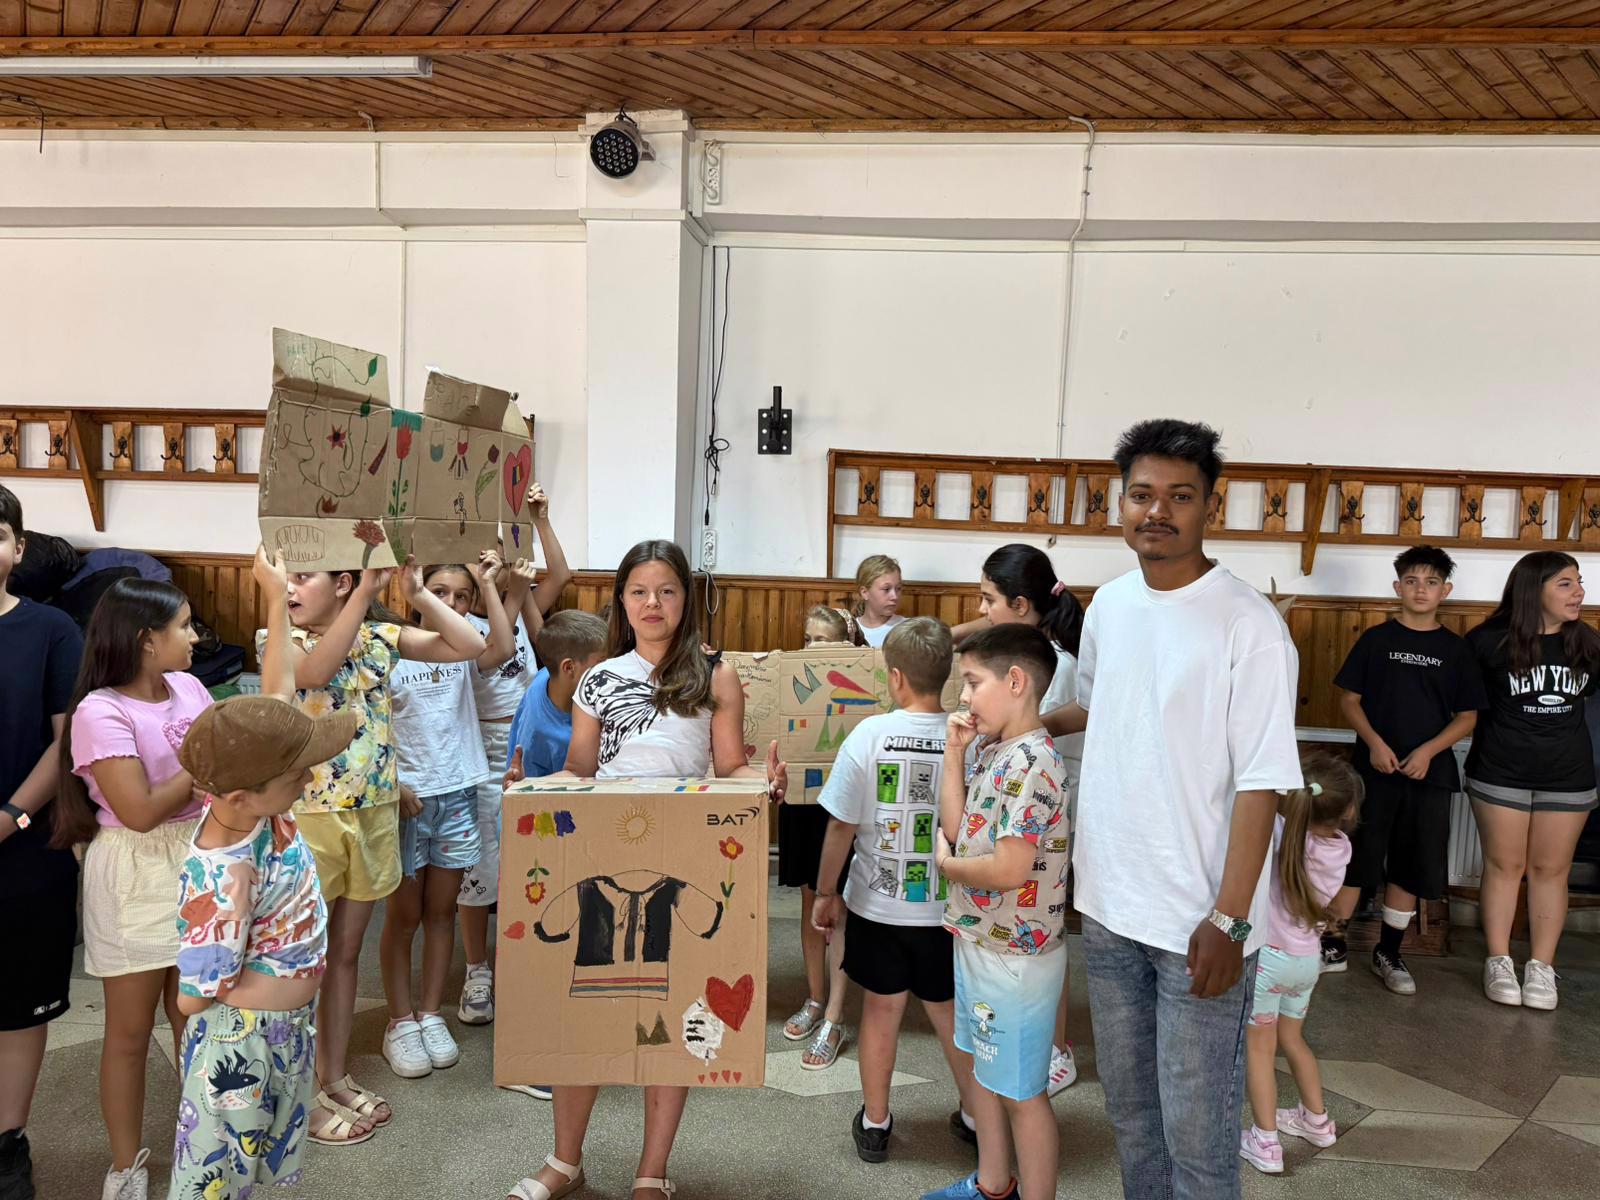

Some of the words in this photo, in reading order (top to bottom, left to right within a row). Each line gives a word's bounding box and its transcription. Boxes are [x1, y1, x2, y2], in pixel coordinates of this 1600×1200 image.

[1389, 651, 1443, 667] LEGENDARY
[401, 667, 462, 685] HAPPNESS
[1508, 665, 1546, 696] NEW
[1522, 705, 1537, 713] THE
[707, 814, 748, 825] BAT
